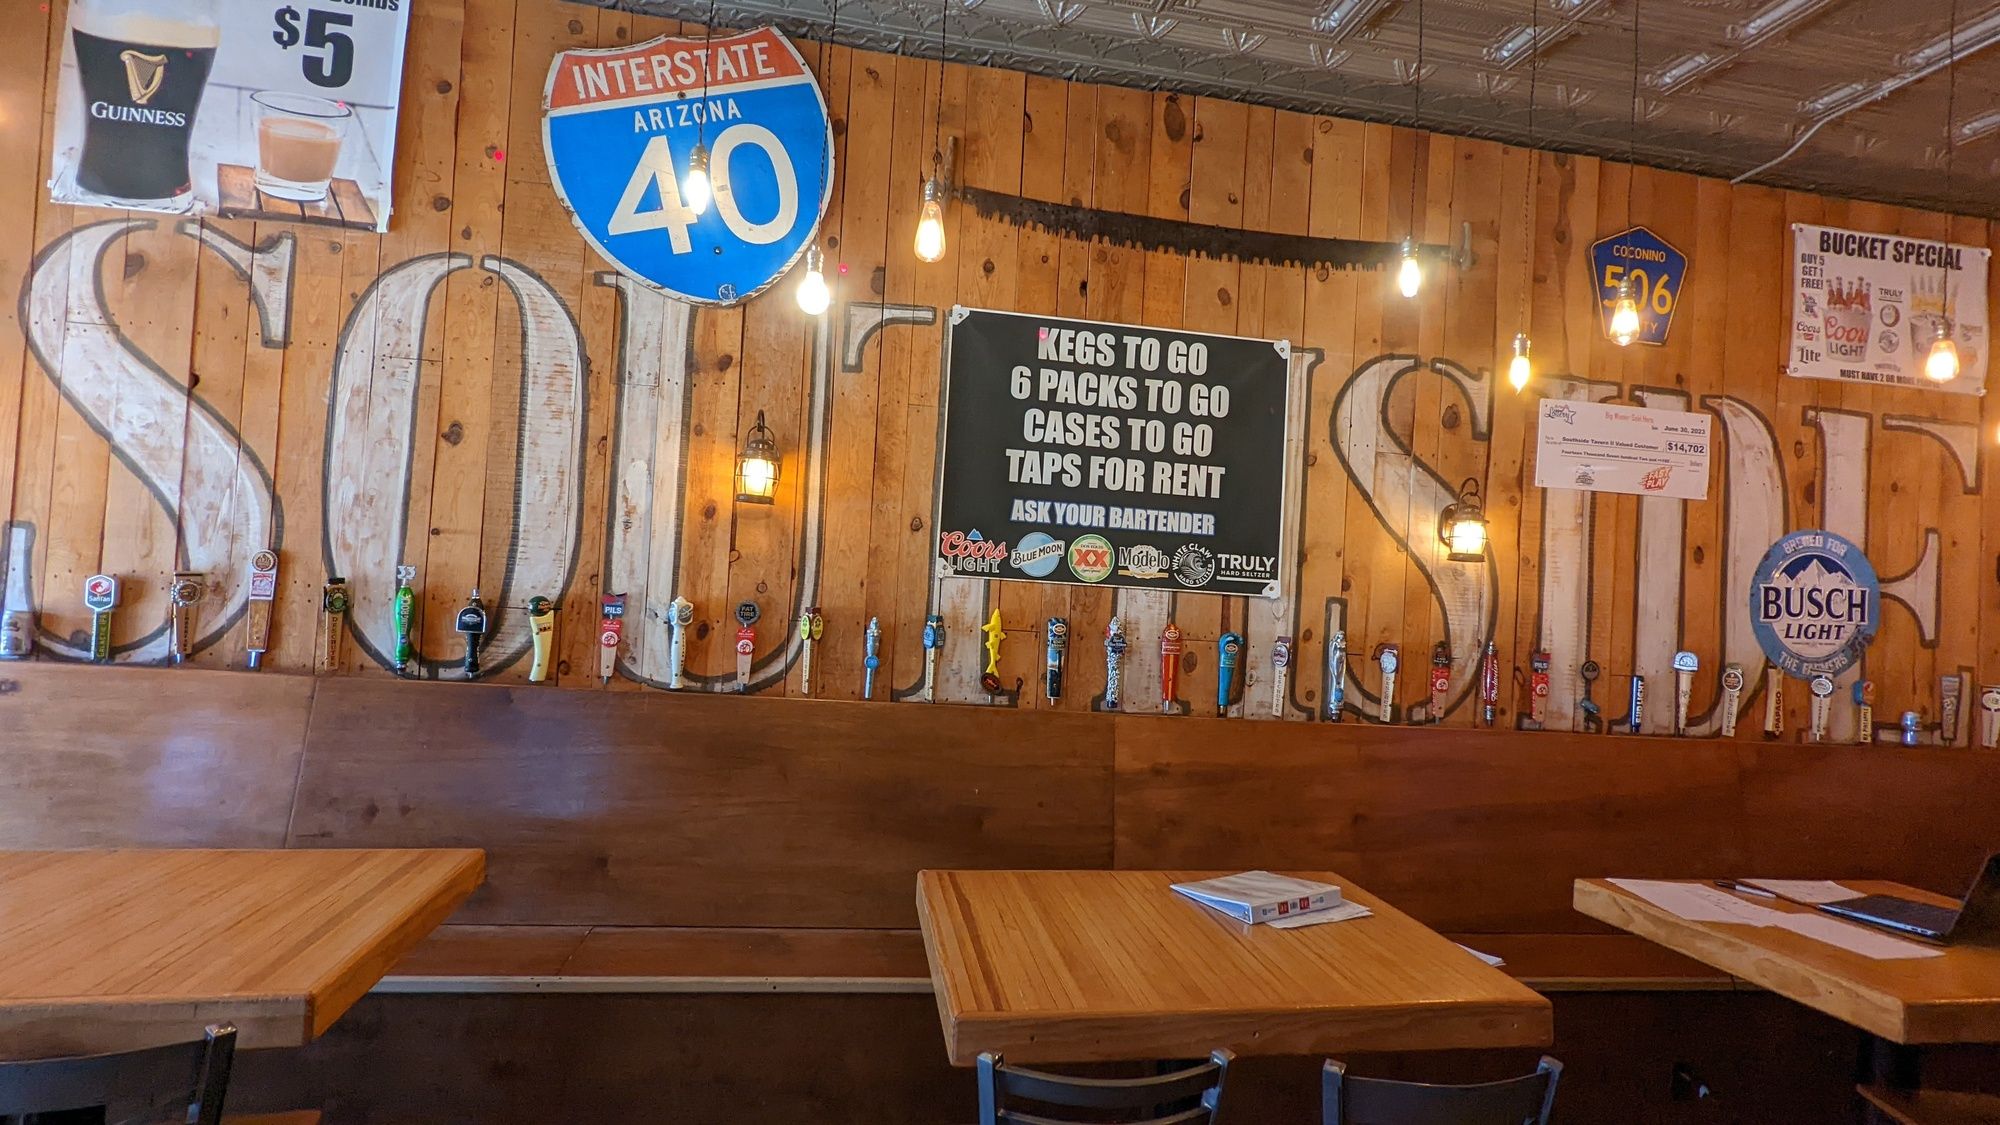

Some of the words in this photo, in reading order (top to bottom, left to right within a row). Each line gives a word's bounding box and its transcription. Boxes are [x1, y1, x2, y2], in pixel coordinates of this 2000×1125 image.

[272, 5, 355, 88] $5
[572, 41, 776, 99] INTERSTATE
[91, 101, 186, 128] GUINNESS
[633, 98, 743, 133] ARIZONA
[607, 123, 799, 255] 40
[1613, 245, 1666, 262] COCONINO
[1801, 253, 1818, 265] BUY
[1819, 230, 1889, 260] BUCKET
[1892, 240, 1963, 271] SPECIAL
[1802, 265, 1818, 277] GET
[1603, 264, 1673, 315] 506
[1801, 277, 1824, 289] FREE!
[1878, 287, 1903, 297] TRULY
[1037, 327, 1116, 367] KEGS
[1122, 336, 1161, 371] TO
[1167, 341, 1208, 376] GO
[1840, 369, 1860, 379] MUST
[1880, 373, 1885, 382] 2
[1010, 365, 1032, 400] 6
[1038, 368, 1138, 411] PACKS
[1145, 379, 1182, 414] TO
[1189, 384, 1230, 418] GO
[1023, 408, 1121, 450] CASES
[1127, 418, 1165, 453] TO
[1172, 422, 1213, 457] GO
[1667, 442, 1705, 454] $14,702
[1005, 449, 1082, 487] TAPS
[1088, 456, 1145, 493] FOR
[1152, 462, 1225, 499] RENT
[1010, 498, 1051, 525] ASK
[1054, 502, 1106, 529] YOUR
[1108, 506, 1216, 536] BARTENDER
[941, 530, 1008, 560] Coors
[1012, 549, 1038, 566] BLUE
[1039, 543, 1064, 558] MOON
[948, 556, 1000, 573] LIGHT
[1074, 548, 1110, 568] XX
[1118, 546, 1170, 570] Modelo
[1172, 545, 1188, 571] WHITE
[1189, 543, 1213, 559] CLAW
[1217, 553, 1275, 572] TRULY
[397, 565, 417, 579] 33
[1241, 571, 1271, 579] SELTZER
[604, 605, 623, 616] PILS
[1761, 585, 1868, 623] BUSCH
[1784, 623, 1846, 640] LIGHT
[1779, 651, 1799, 672] THE
